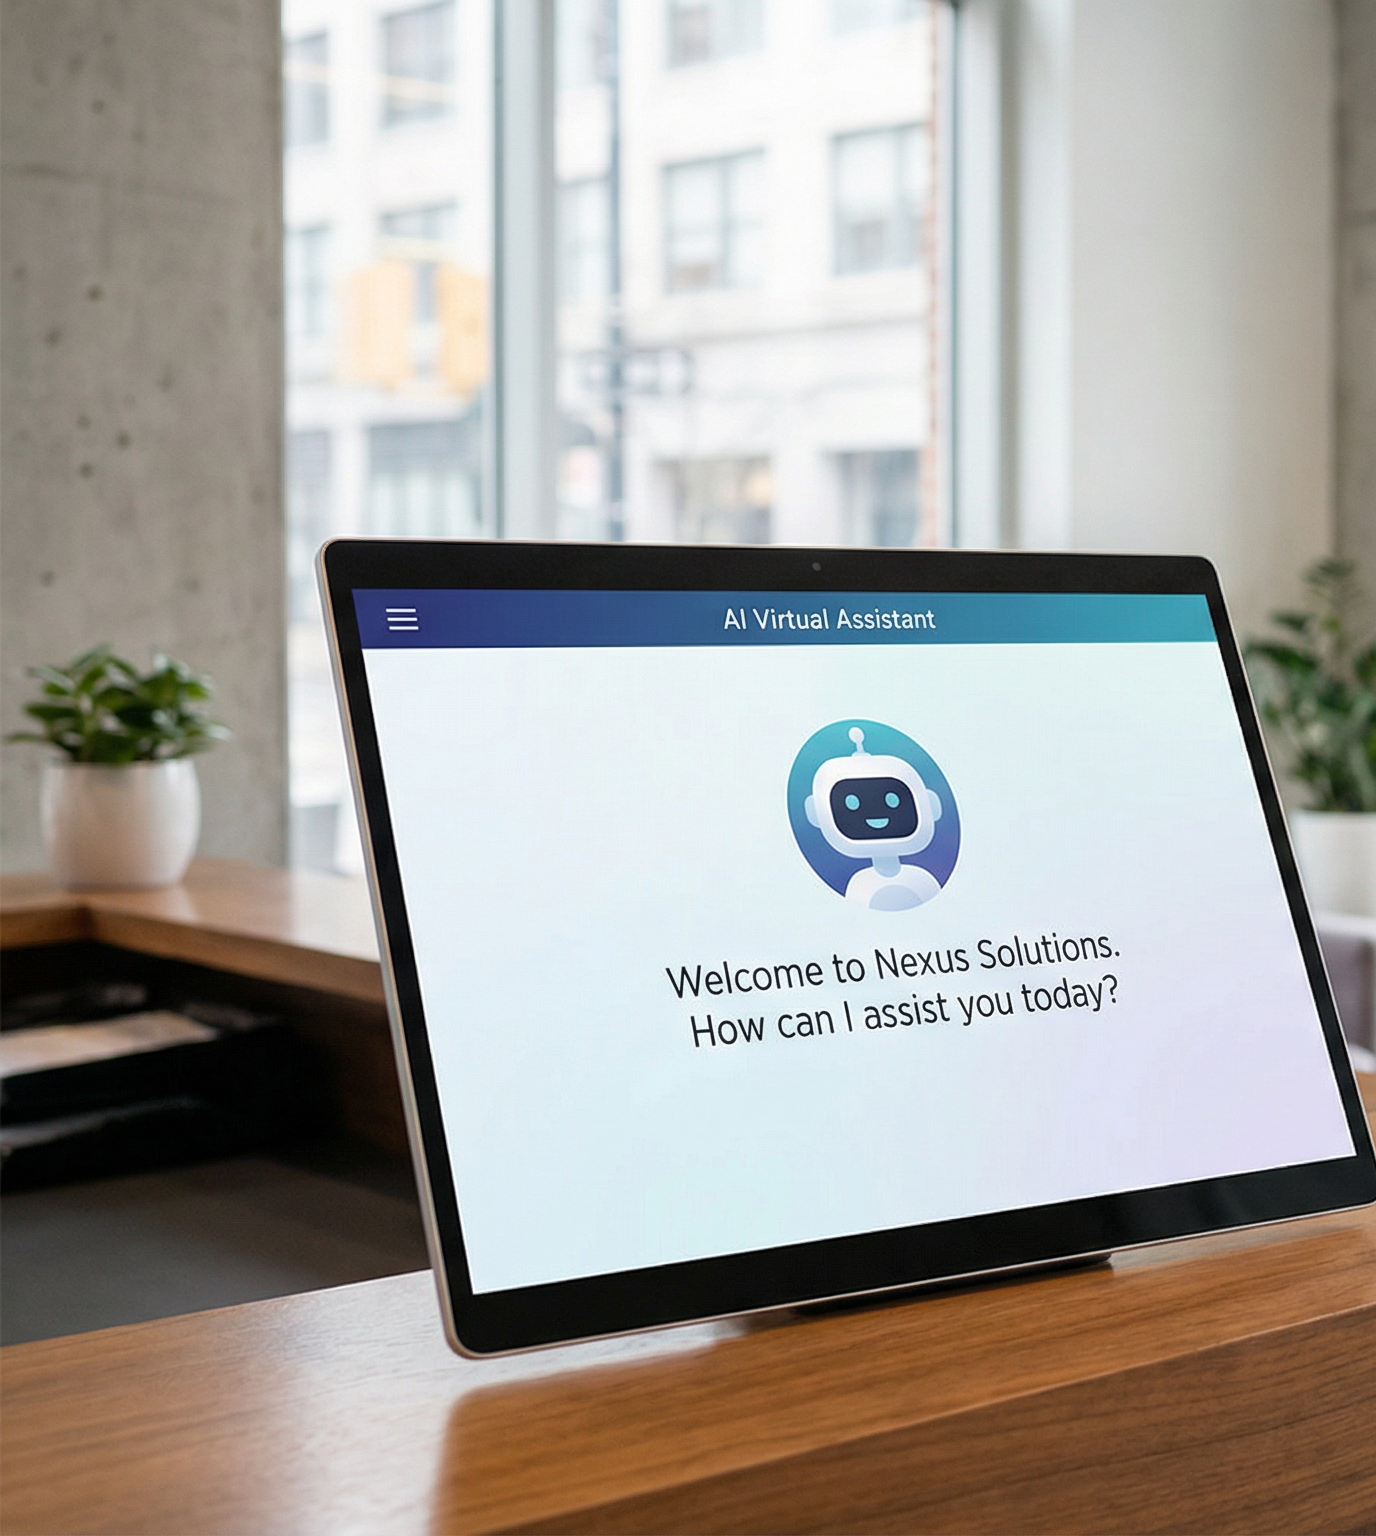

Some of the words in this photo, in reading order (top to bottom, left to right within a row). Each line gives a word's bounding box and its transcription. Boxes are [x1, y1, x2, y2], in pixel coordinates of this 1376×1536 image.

[724, 608, 747, 630] AI
[752, 608, 830, 630] Virtual
[836, 608, 937, 630] Assistant
[665, 960, 824, 999] Welcome
[831, 953, 866, 984] to
[874, 947, 970, 980] Nexus
[977, 932, 1120, 970] Solutions.
[690, 1014, 765, 1048] How
[777, 1010, 835, 1039] can
[843, 1000, 853, 1033] I
[863, 992, 951, 1030] assist
[956, 991, 1014, 1027] you
[1020, 974, 1118, 1013] today?
